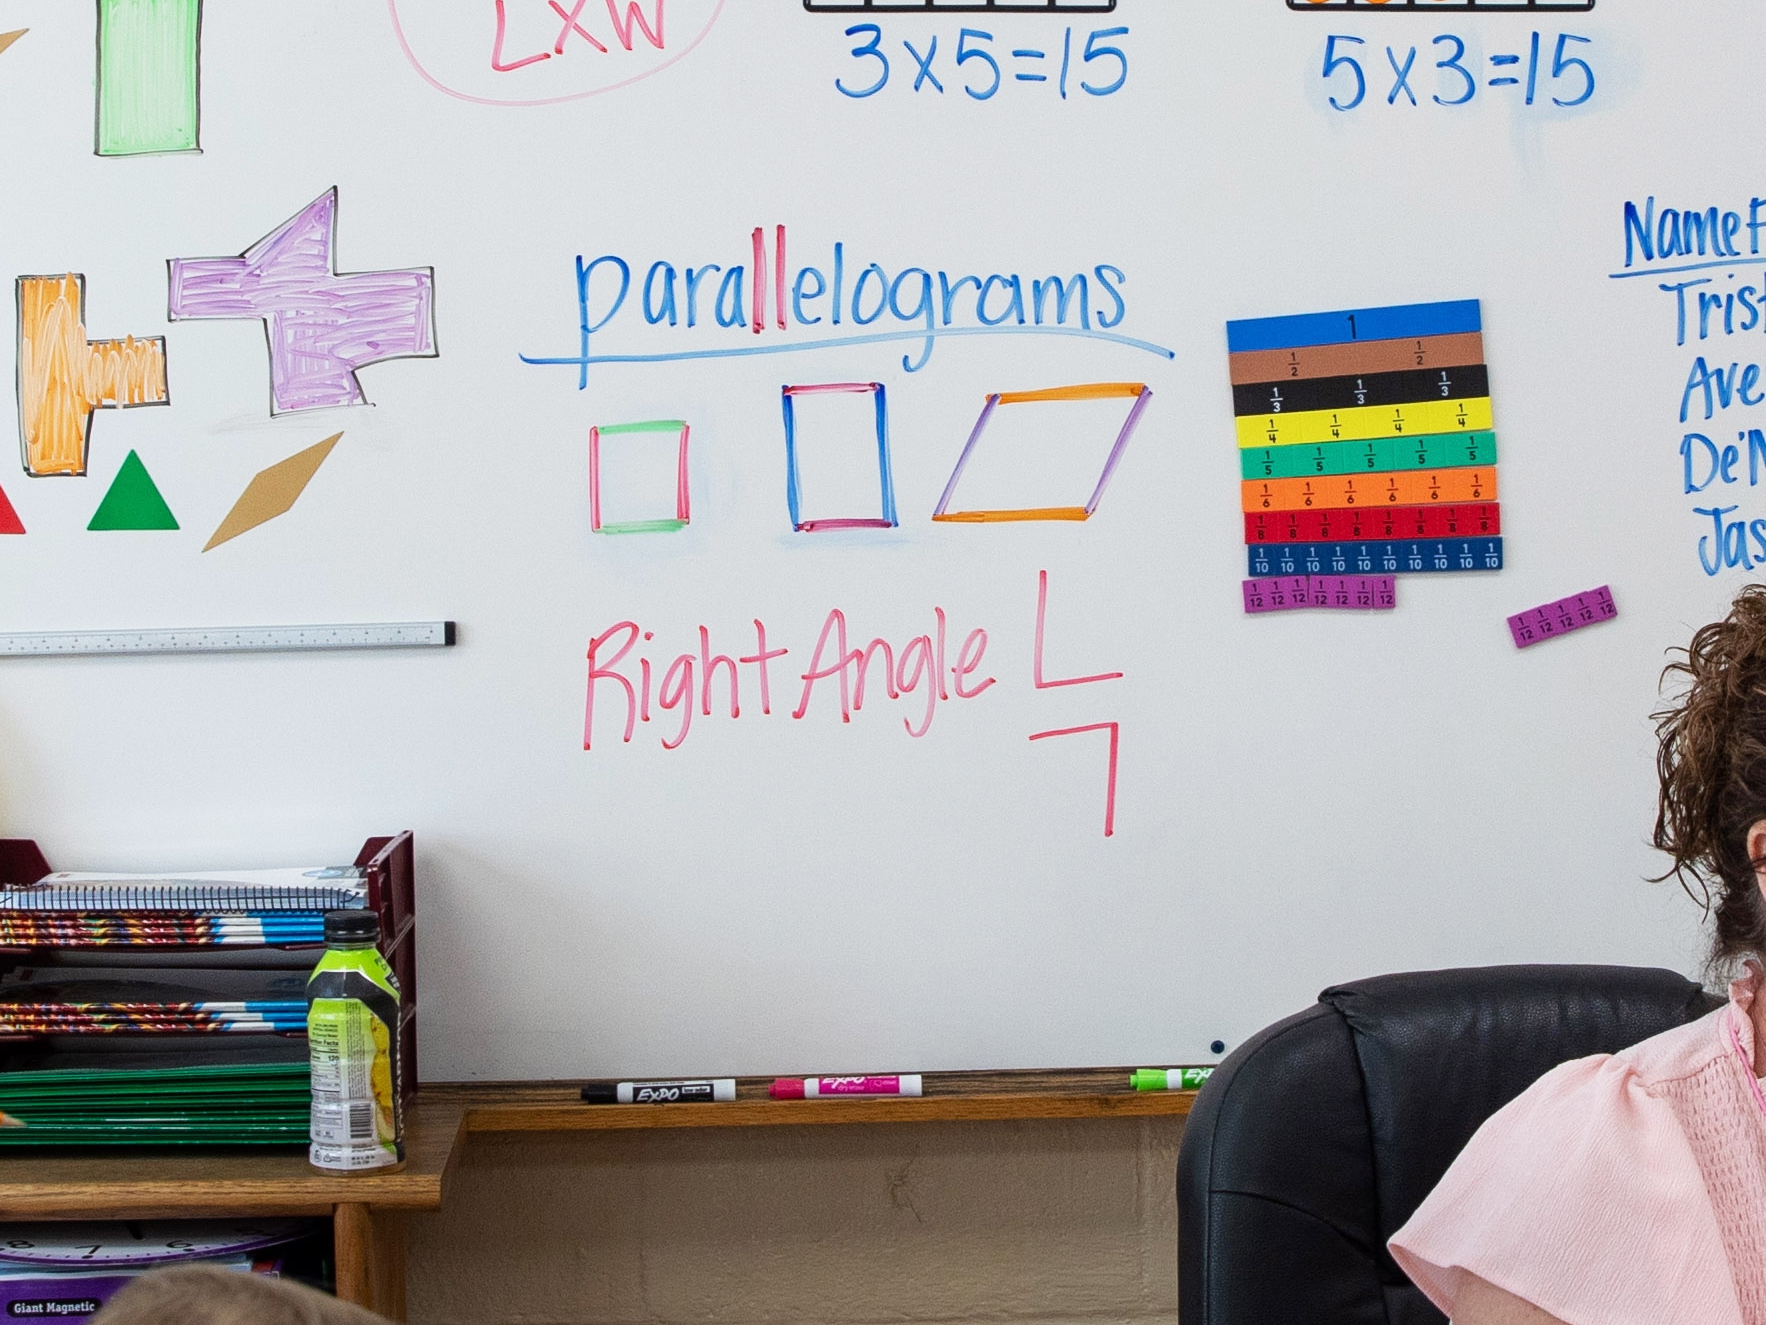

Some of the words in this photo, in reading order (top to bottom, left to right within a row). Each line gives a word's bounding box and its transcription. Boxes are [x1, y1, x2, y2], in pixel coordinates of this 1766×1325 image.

[1346, 314, 1357, 340] 1
[583, 617, 788, 751] Right
[792, 607, 997, 738] Angle
[637, 1088, 680, 1101] EXPO
[14, 1303, 44, 1313] Giant
[46, 1301, 95, 1314] Magnetic
